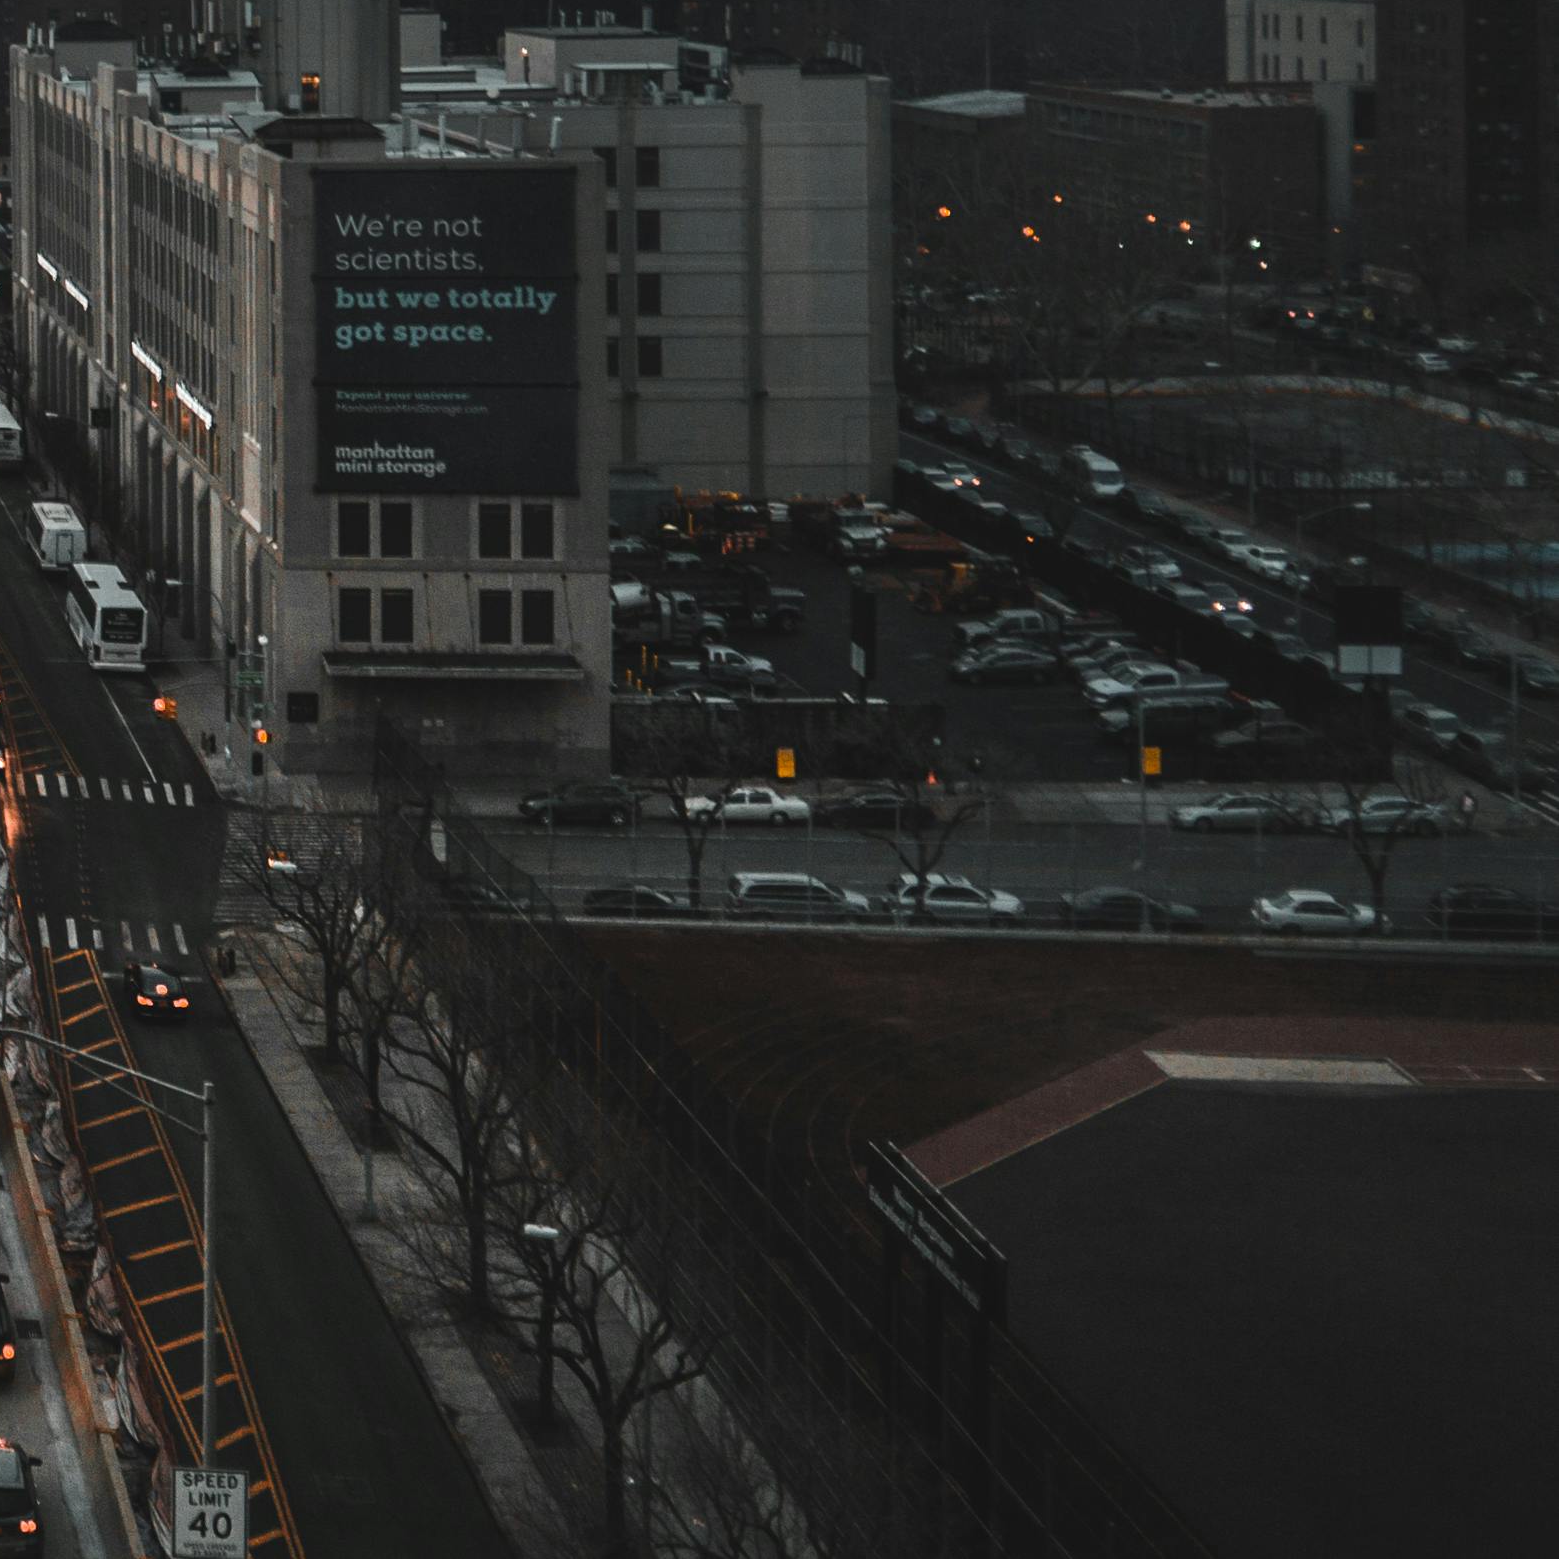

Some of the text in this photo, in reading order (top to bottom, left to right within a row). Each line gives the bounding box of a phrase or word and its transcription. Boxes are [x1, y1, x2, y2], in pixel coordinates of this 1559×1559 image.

[334, 212, 483, 238] We're not
[334, 286, 557, 316] but we totally
[334, 321, 494, 350] got space.
[384, 392, 412, 402] your
[335, 439, 435, 459] manhattan
[335, 459, 447, 478] mini storage
[182, 1472, 238, 1489] SPEED
[188, 1491, 232, 1508] LIMIT
[188, 1510, 233, 1539] 40
